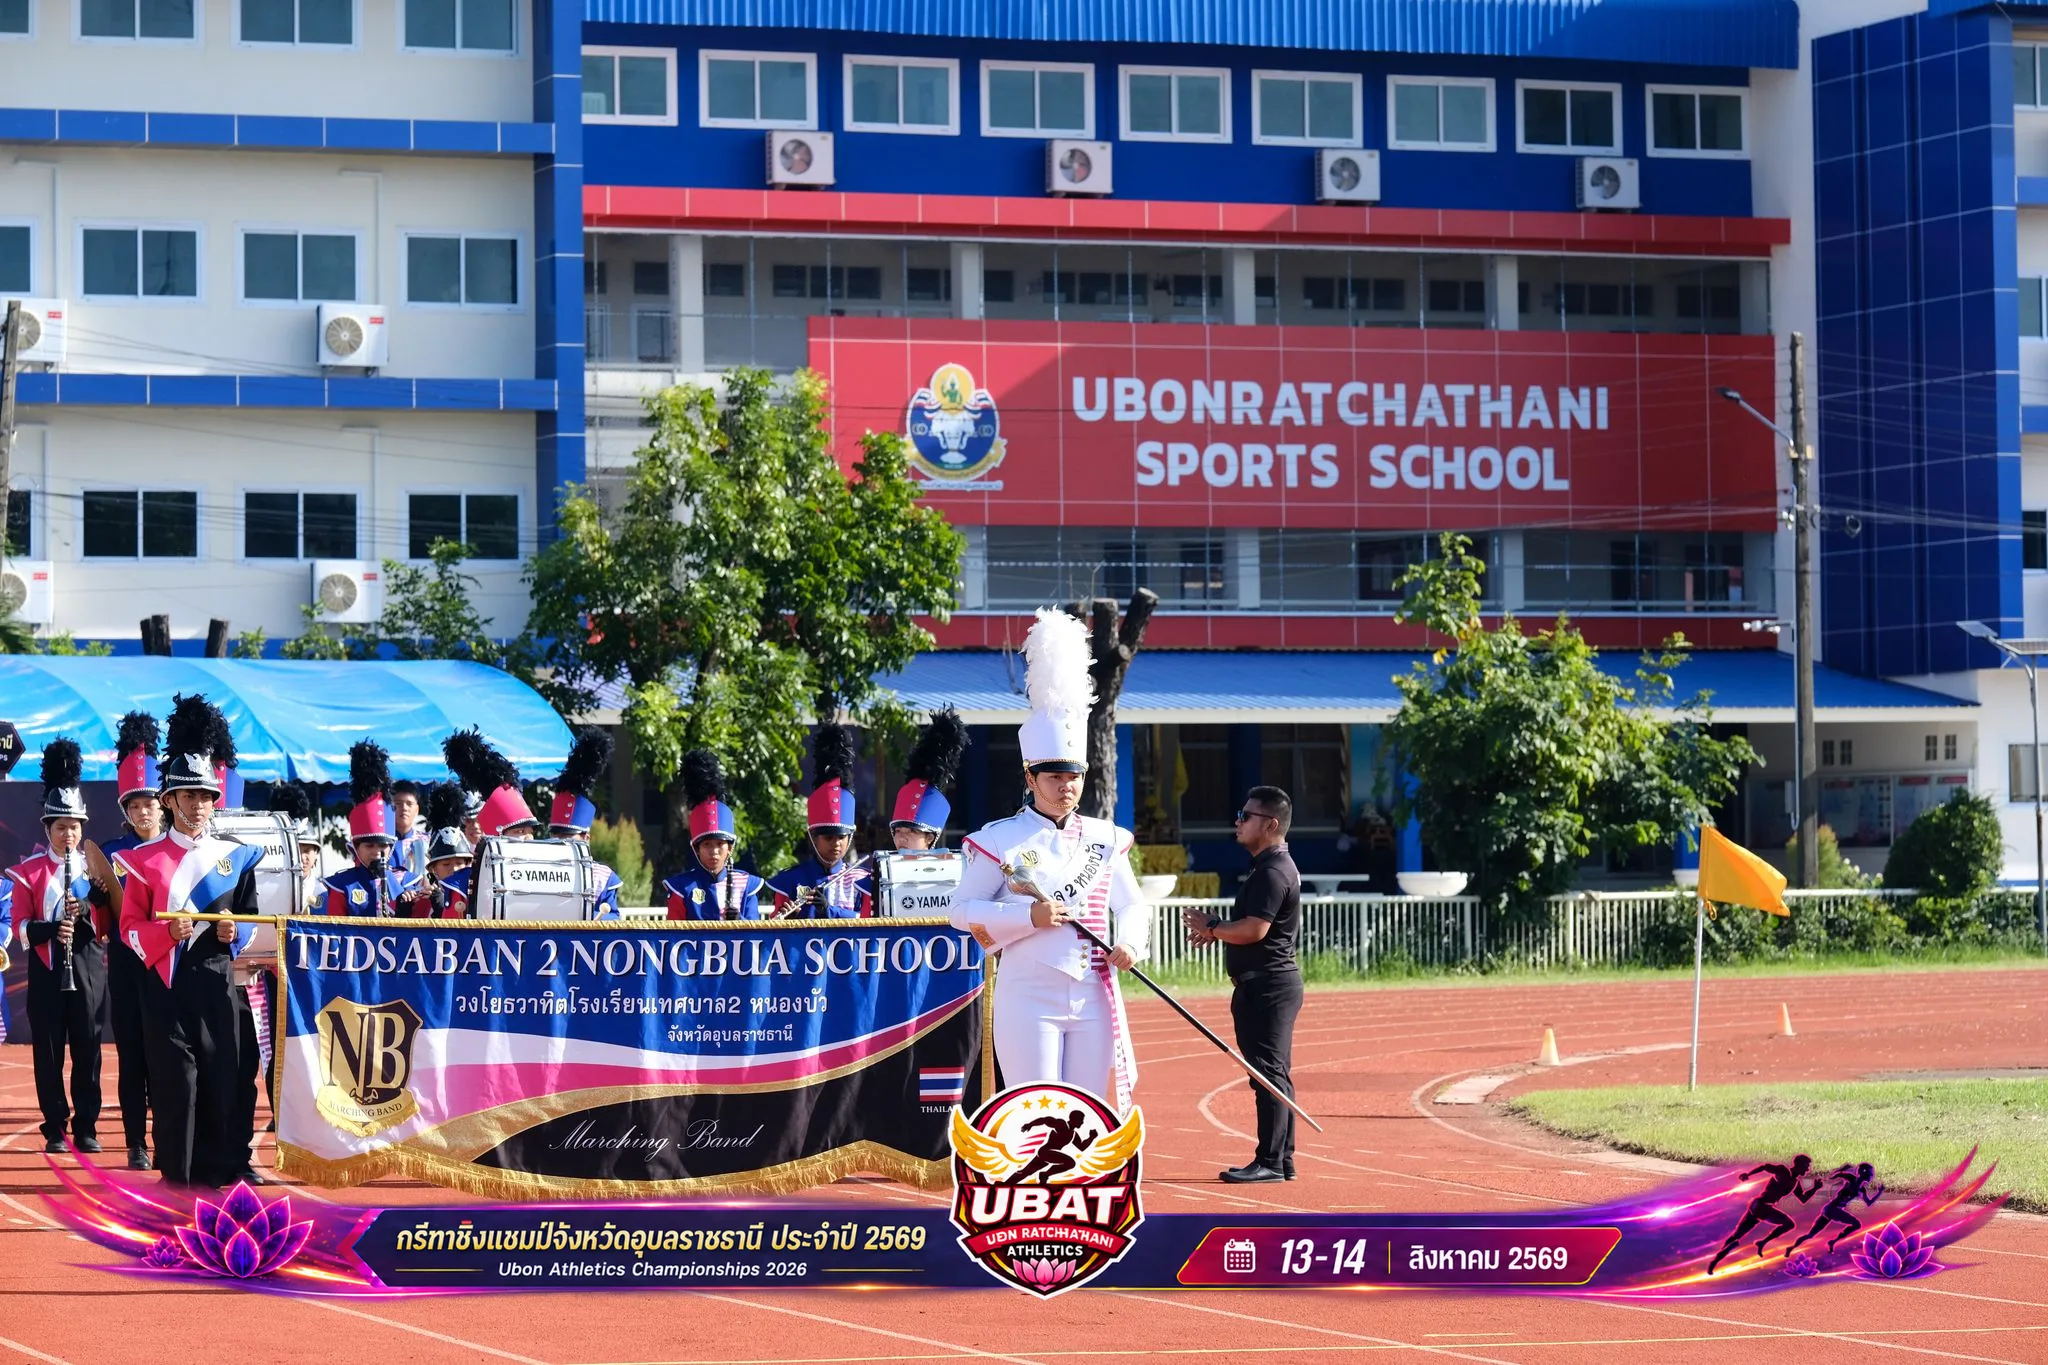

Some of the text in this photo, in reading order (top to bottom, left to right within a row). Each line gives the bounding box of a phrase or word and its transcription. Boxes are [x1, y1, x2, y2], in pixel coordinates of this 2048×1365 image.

[1073, 376, 1609, 430] UBONRATCHATHANI
[1136, 440, 1569, 492] SPORTS SCHOOL
[525, 870, 571, 883] YAMAHA
[1064, 883, 1077, 898] 2
[1073, 843, 1105, 889] หนองบัว
[290, 932, 981, 976] TEDSABAN 2 NONGBUA SCHOOL
[455, 986, 828, 1015] วงโยธวาทิตโรงเรียนเทศบาล2 หนองบัว
[325, 1011, 406, 1098] NB
[667, 1023, 793, 1048] จังหวัดอุบลราชธานี
[377, 1102, 403, 1116] BAND
[549, 1118, 765, 1162] Marching Band
